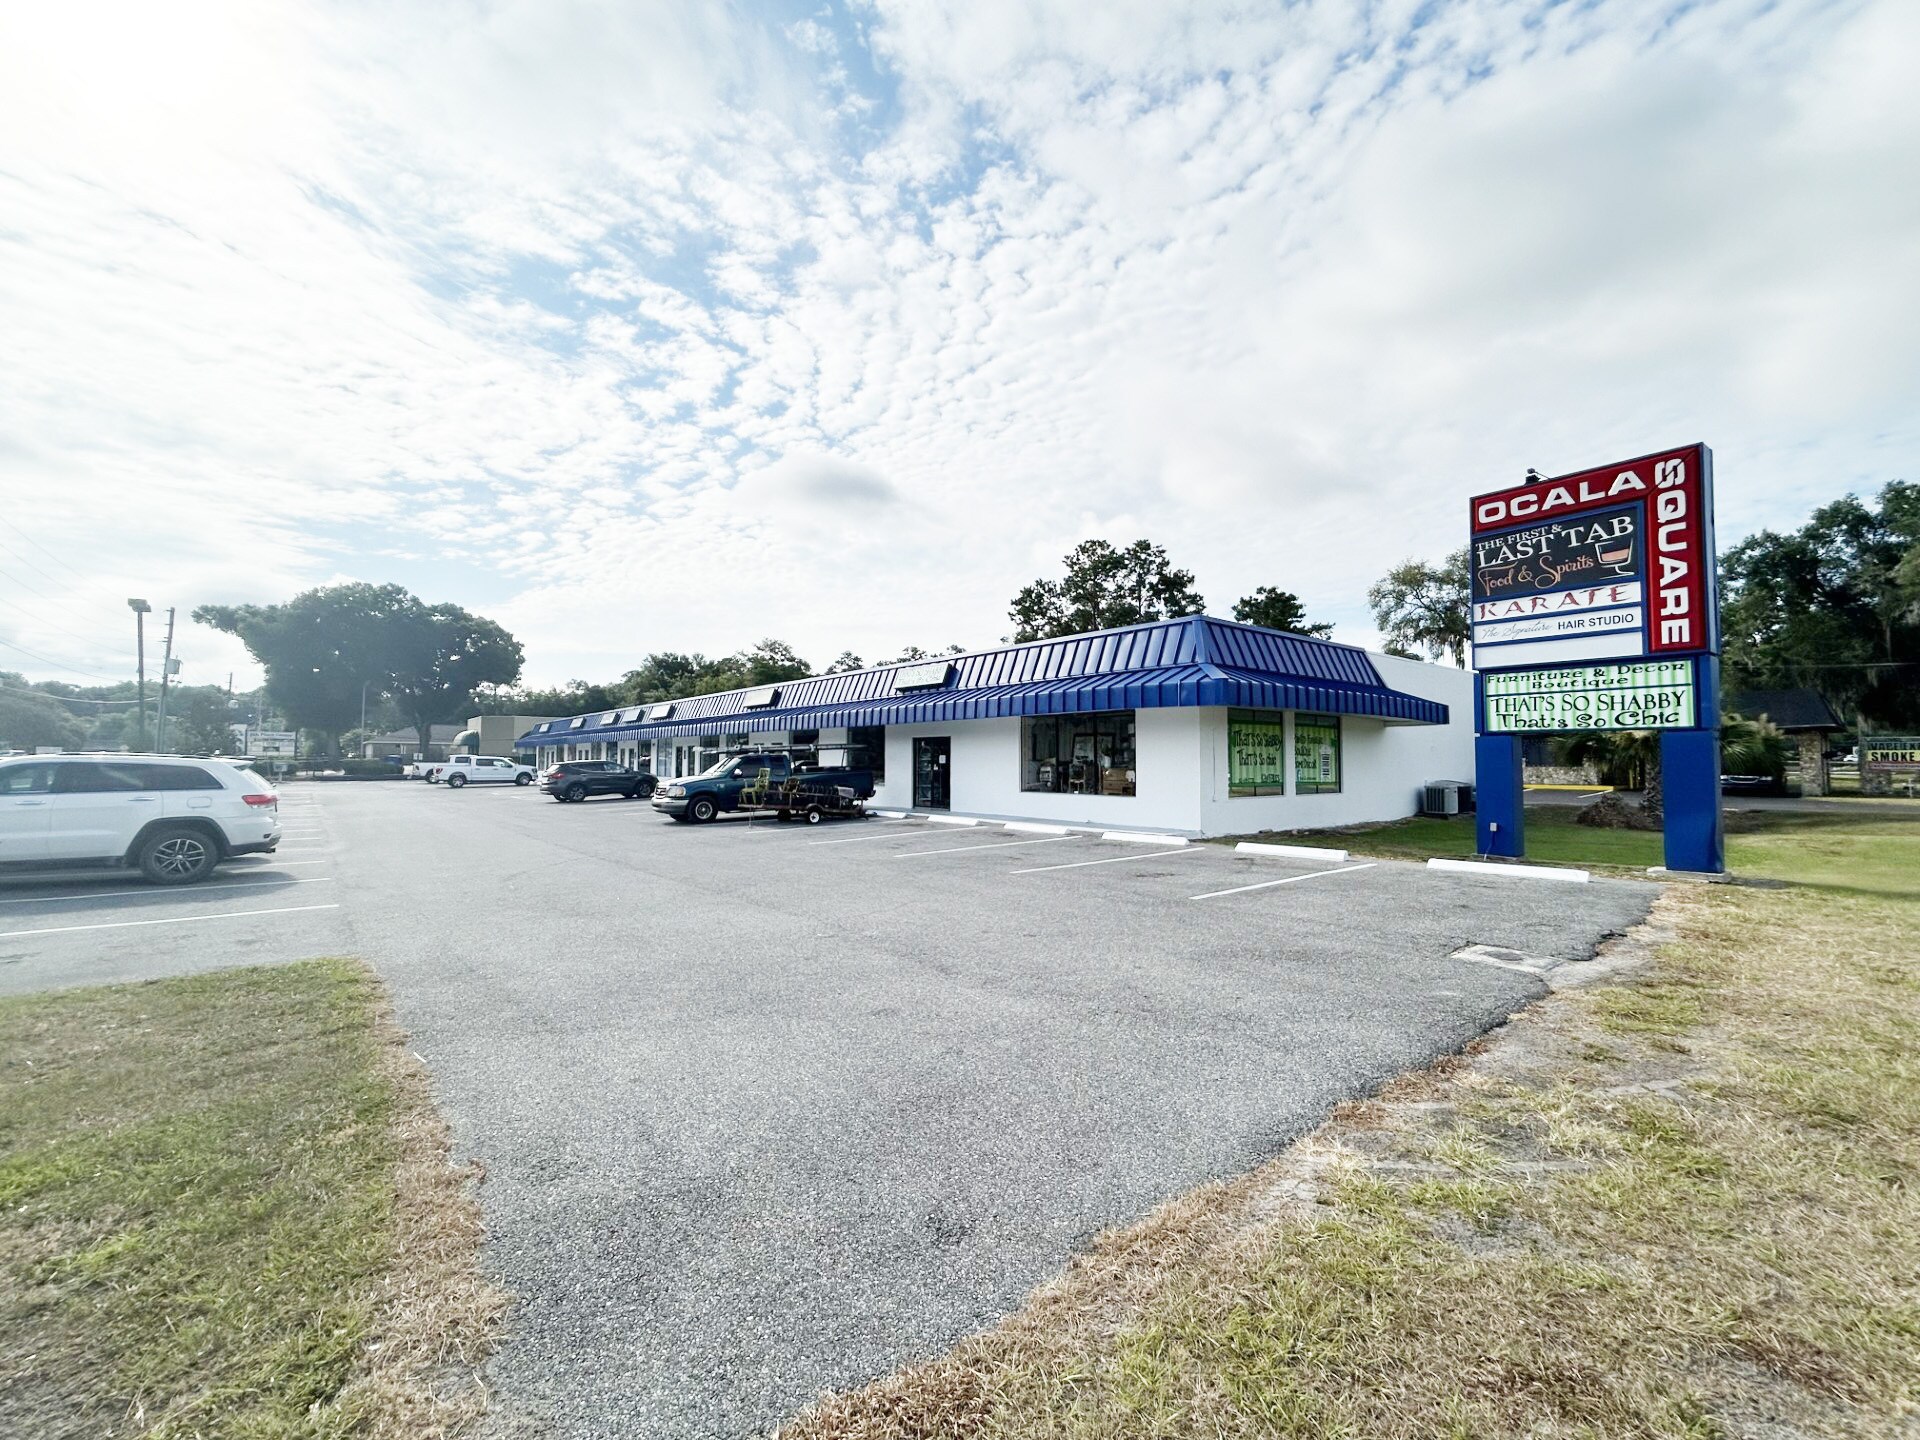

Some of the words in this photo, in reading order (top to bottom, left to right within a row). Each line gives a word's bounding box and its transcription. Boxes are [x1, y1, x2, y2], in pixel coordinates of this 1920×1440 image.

[1478, 470, 1646, 524] OCALA
[1475, 536, 1503, 552] THE
[1504, 527, 1549, 546] FIRST
[1551, 523, 1563, 533] &
[1477, 534, 1555, 569] LAST
[1561, 515, 1634, 548] TAB
[1654, 458, 1691, 645] SQUARE
[1477, 561, 1518, 597] Food
[1518, 565, 1533, 582] &
[1534, 555, 1594, 589] Spirits
[1478, 584, 1634, 620] KARATE
[1482, 625, 1500, 639] The
[1557, 619, 1585, 631] HAIR
[1588, 613, 1635, 627] STUDIO
[1487, 669, 1583, 685] Furniture
[1593, 668, 1606, 678] &
[1617, 662, 1685, 675] Decor
[1532, 676, 1629, 689] Boutique
[1490, 696, 1555, 713] THAT'S
[1561, 694, 1590, 711] SO
[1597, 690, 1686, 711] SHABBY
[1496, 713, 1568, 729] That's
[1576, 713, 1606, 728] So
[1614, 710, 1680, 726] Chic
[1871, 752, 1915, 761] SMOKE
